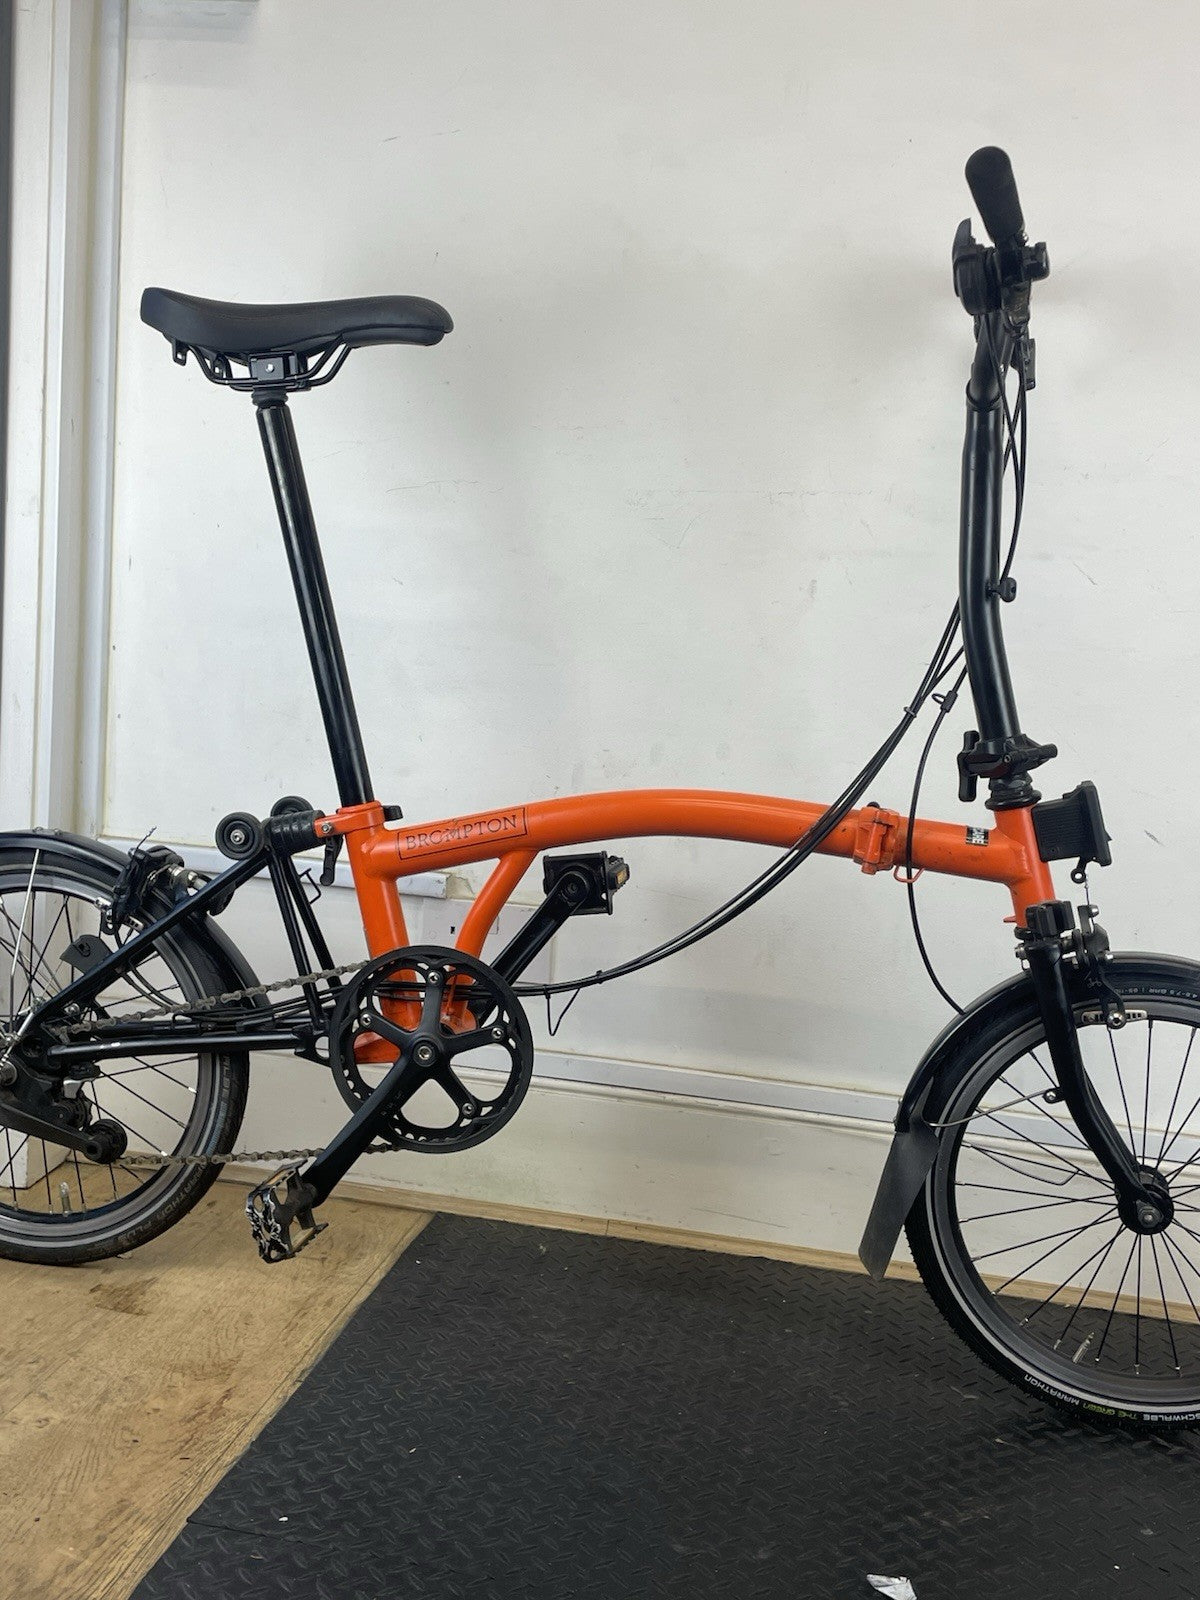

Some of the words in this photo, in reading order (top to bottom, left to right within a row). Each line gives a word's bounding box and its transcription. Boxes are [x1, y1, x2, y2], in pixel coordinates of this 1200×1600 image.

[405, 814, 517, 850] BROMPTON
[1024, 1374, 1080, 1406] MARATHON
[1082, 1402, 1116, 1415] GREEN
[1118, 1410, 1138, 1420] THE
[1143, 1413, 1200, 1422] SCHWALBE
